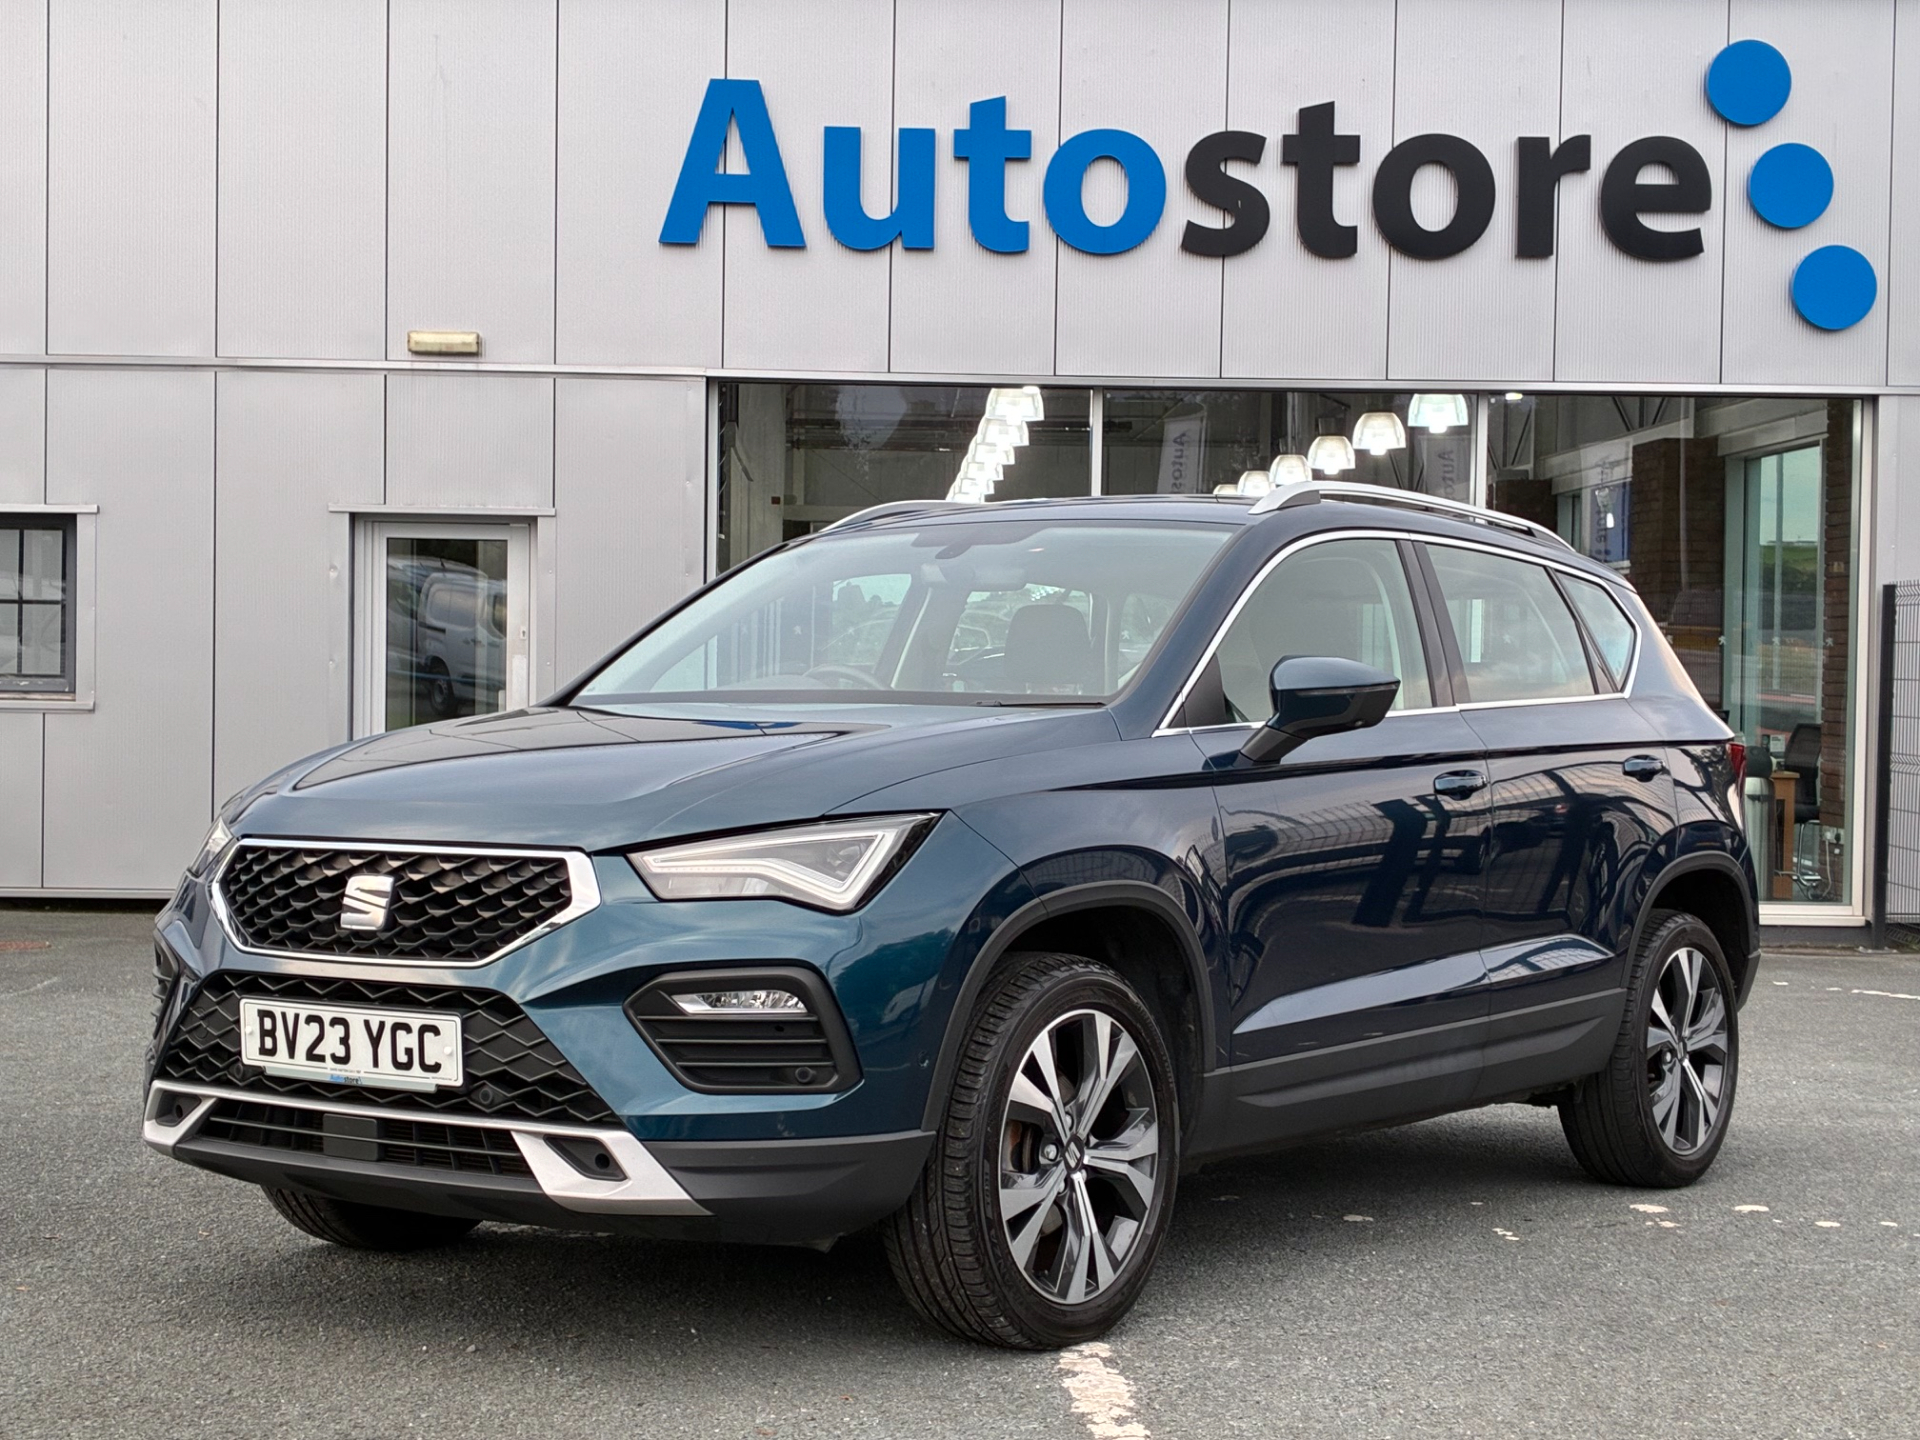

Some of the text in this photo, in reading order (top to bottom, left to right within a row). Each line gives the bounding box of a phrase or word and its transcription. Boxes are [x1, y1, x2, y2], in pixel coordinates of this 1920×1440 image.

[659, 78, 1712, 262] Autostore
[257, 1008, 442, 1073] BV23 YGC
